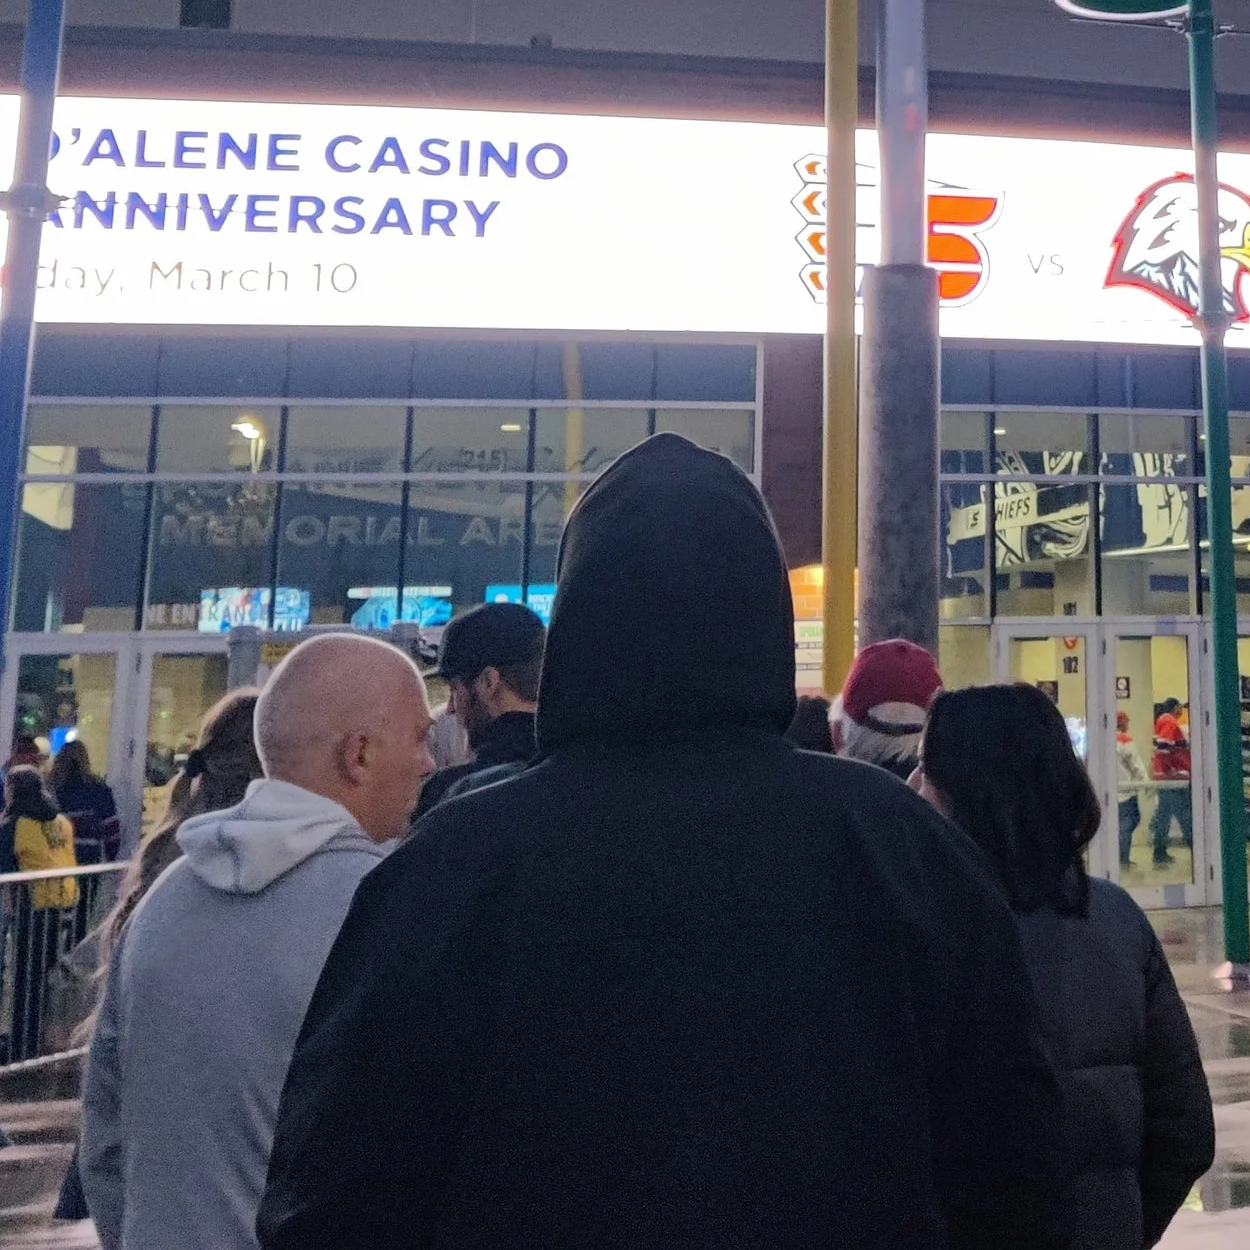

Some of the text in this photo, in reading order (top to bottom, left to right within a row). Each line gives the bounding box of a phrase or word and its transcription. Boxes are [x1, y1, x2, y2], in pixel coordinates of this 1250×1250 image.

[324, 134, 568, 180] CASINO
[149, 261, 289, 293] March
[313, 263, 358, 293] 10
[996, 496, 1031, 523] HIEFS
[160, 514, 562, 546] MEMORIAL ARE
